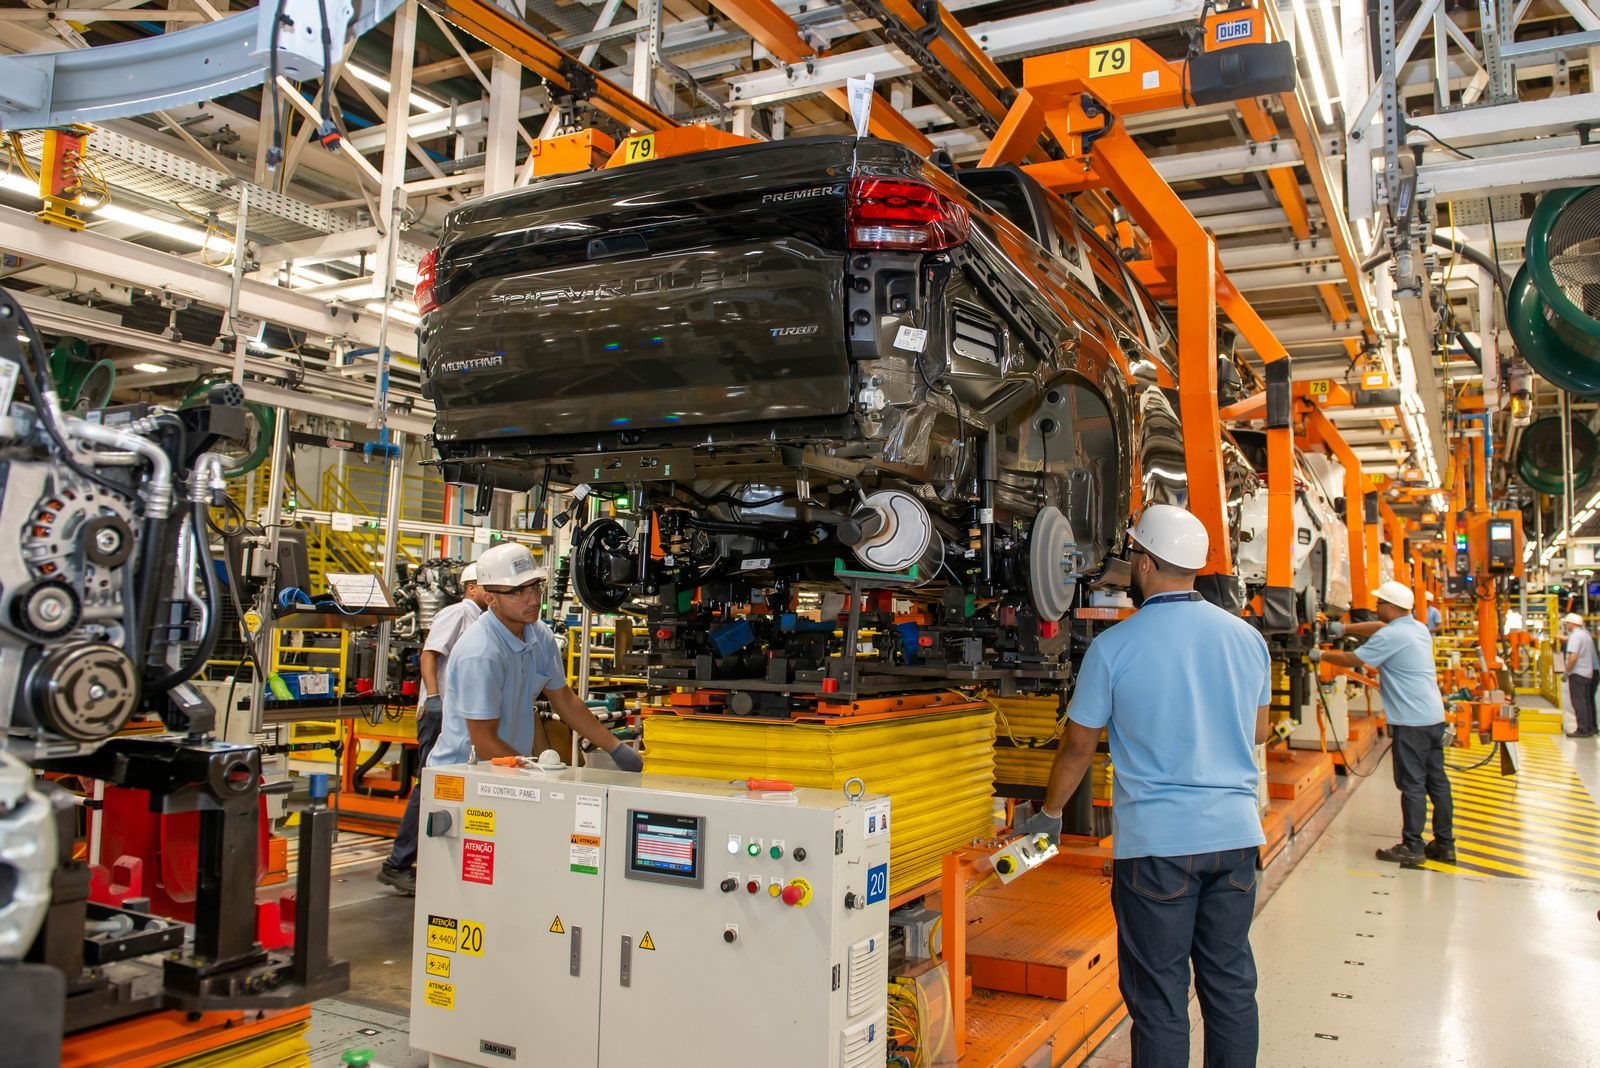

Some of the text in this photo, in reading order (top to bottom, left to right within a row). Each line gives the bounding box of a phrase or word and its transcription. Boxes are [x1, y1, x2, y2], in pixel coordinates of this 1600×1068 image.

[1095, 47, 1126, 73] 79
[630, 138, 651, 160] 79
[762, 187, 833, 204] PREMIER
[770, 326, 818, 337] TURBO
[441, 356, 503, 372] MONTANA
[1312, 382, 1327, 393] 78
[493, 786, 517, 797] CONTROL
[518, 788, 537, 799] PANEL
[466, 809, 493, 819] CUIDADO
[464, 842, 493, 854] ATENÇÃO
[870, 871, 885, 896] 20
[432, 917, 455, 928] ATENÇÃO
[438, 934, 457, 945] 440V
[461, 924, 482, 952] 20
[437, 961, 449, 971] 24V
[428, 982, 452, 992] ATENÇÃO
[484, 1043, 512, 1057] DAIFUKU
